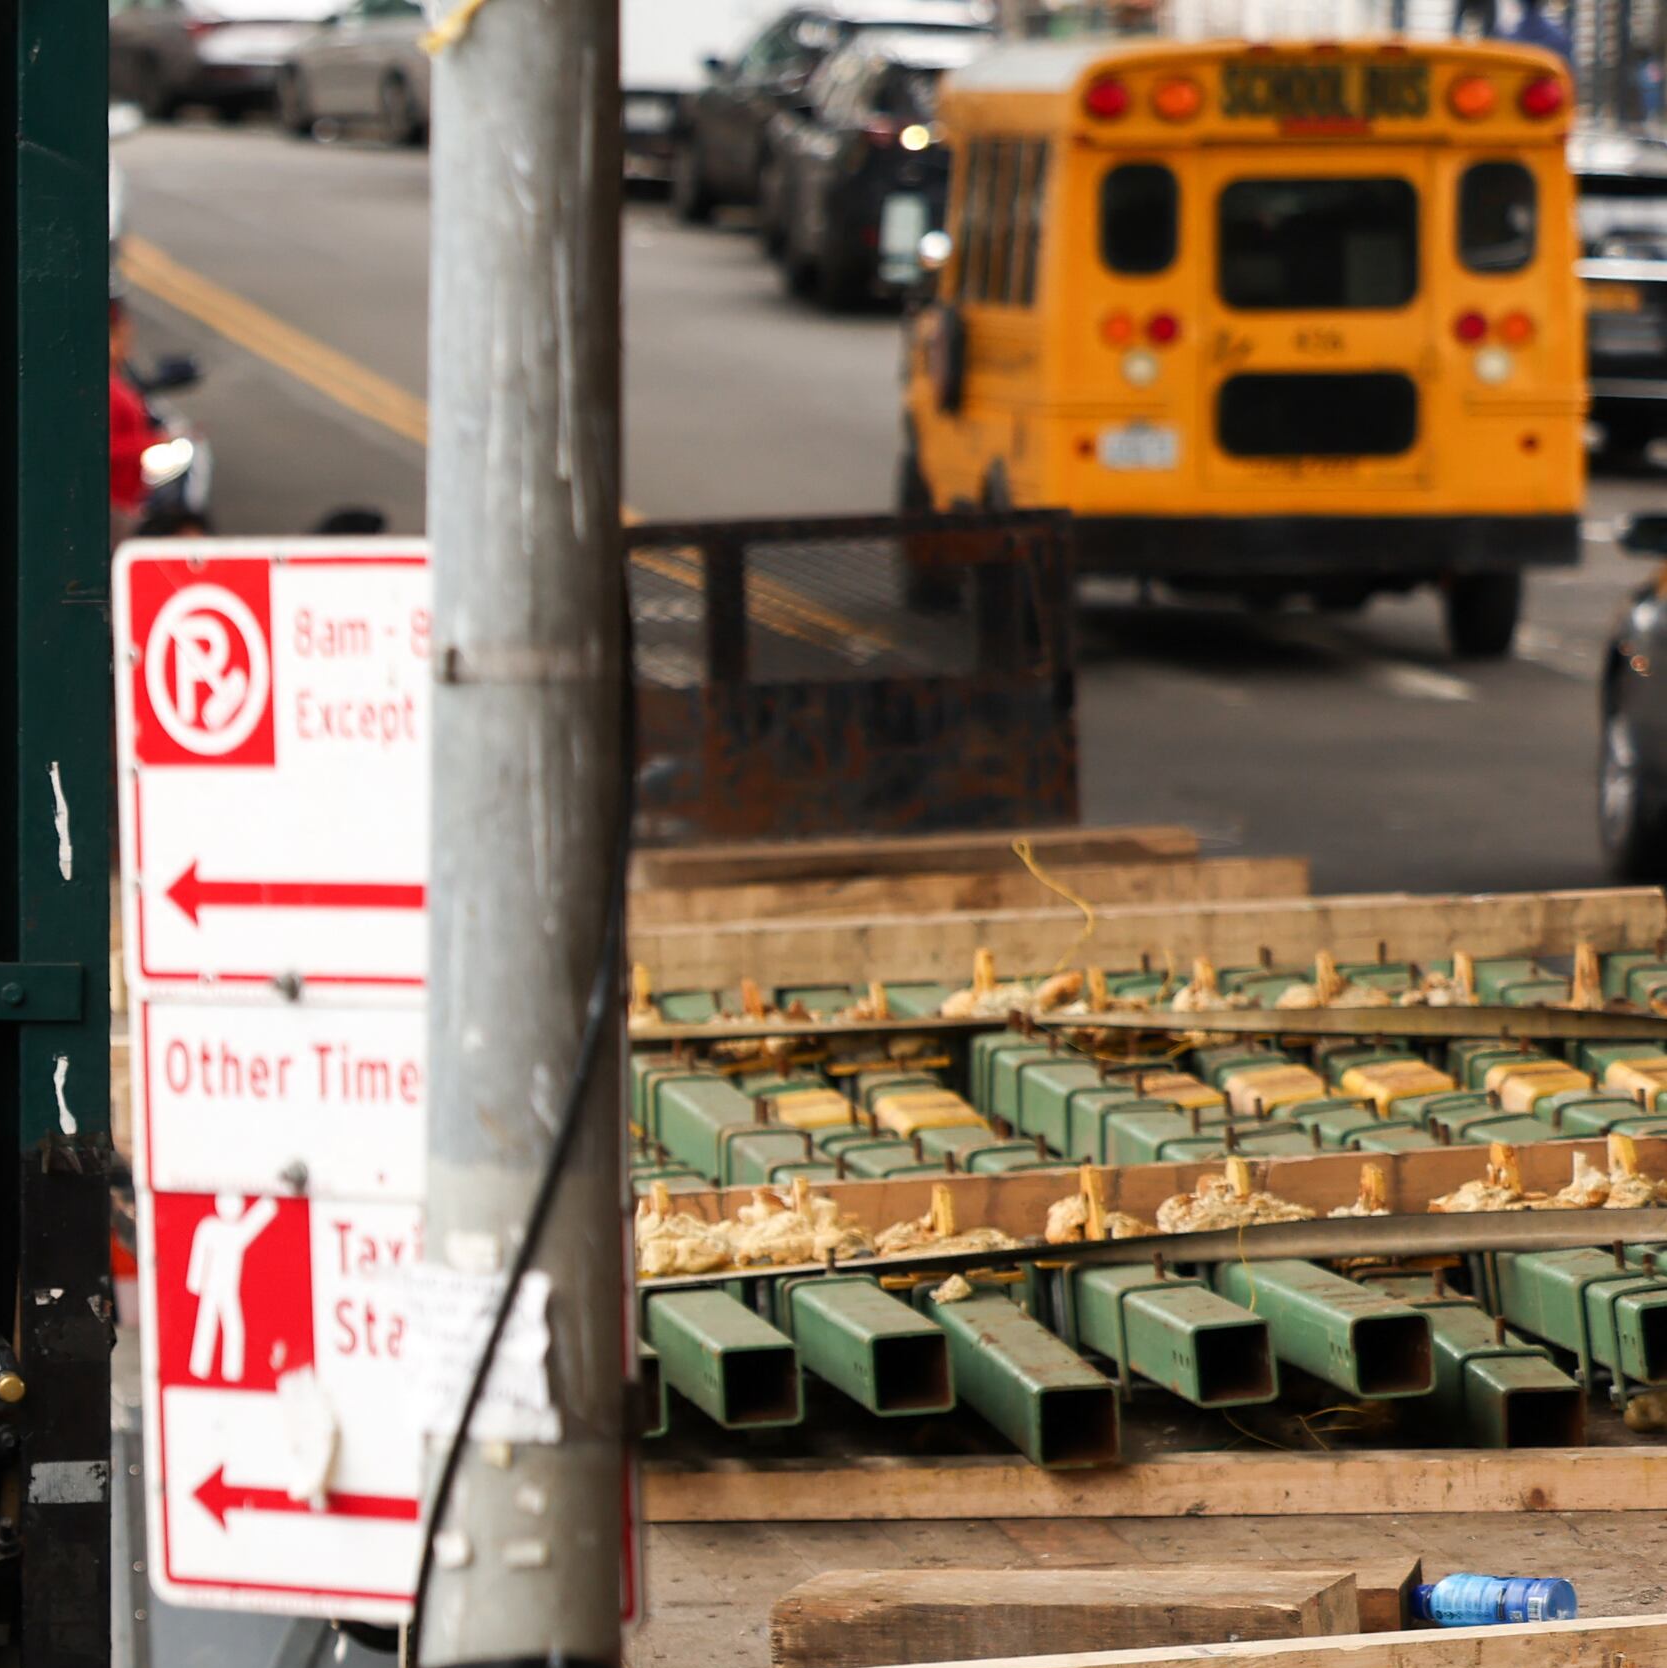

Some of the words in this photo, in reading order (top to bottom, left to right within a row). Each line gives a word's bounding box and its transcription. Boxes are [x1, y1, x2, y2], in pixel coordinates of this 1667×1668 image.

[1221, 62, 1344, 118] SCHOOL
[1366, 62, 1429, 118] BUS
[294, 606, 371, 659] 8am
[296, 686, 418, 750] Except
[164, 1038, 292, 1099] Other
